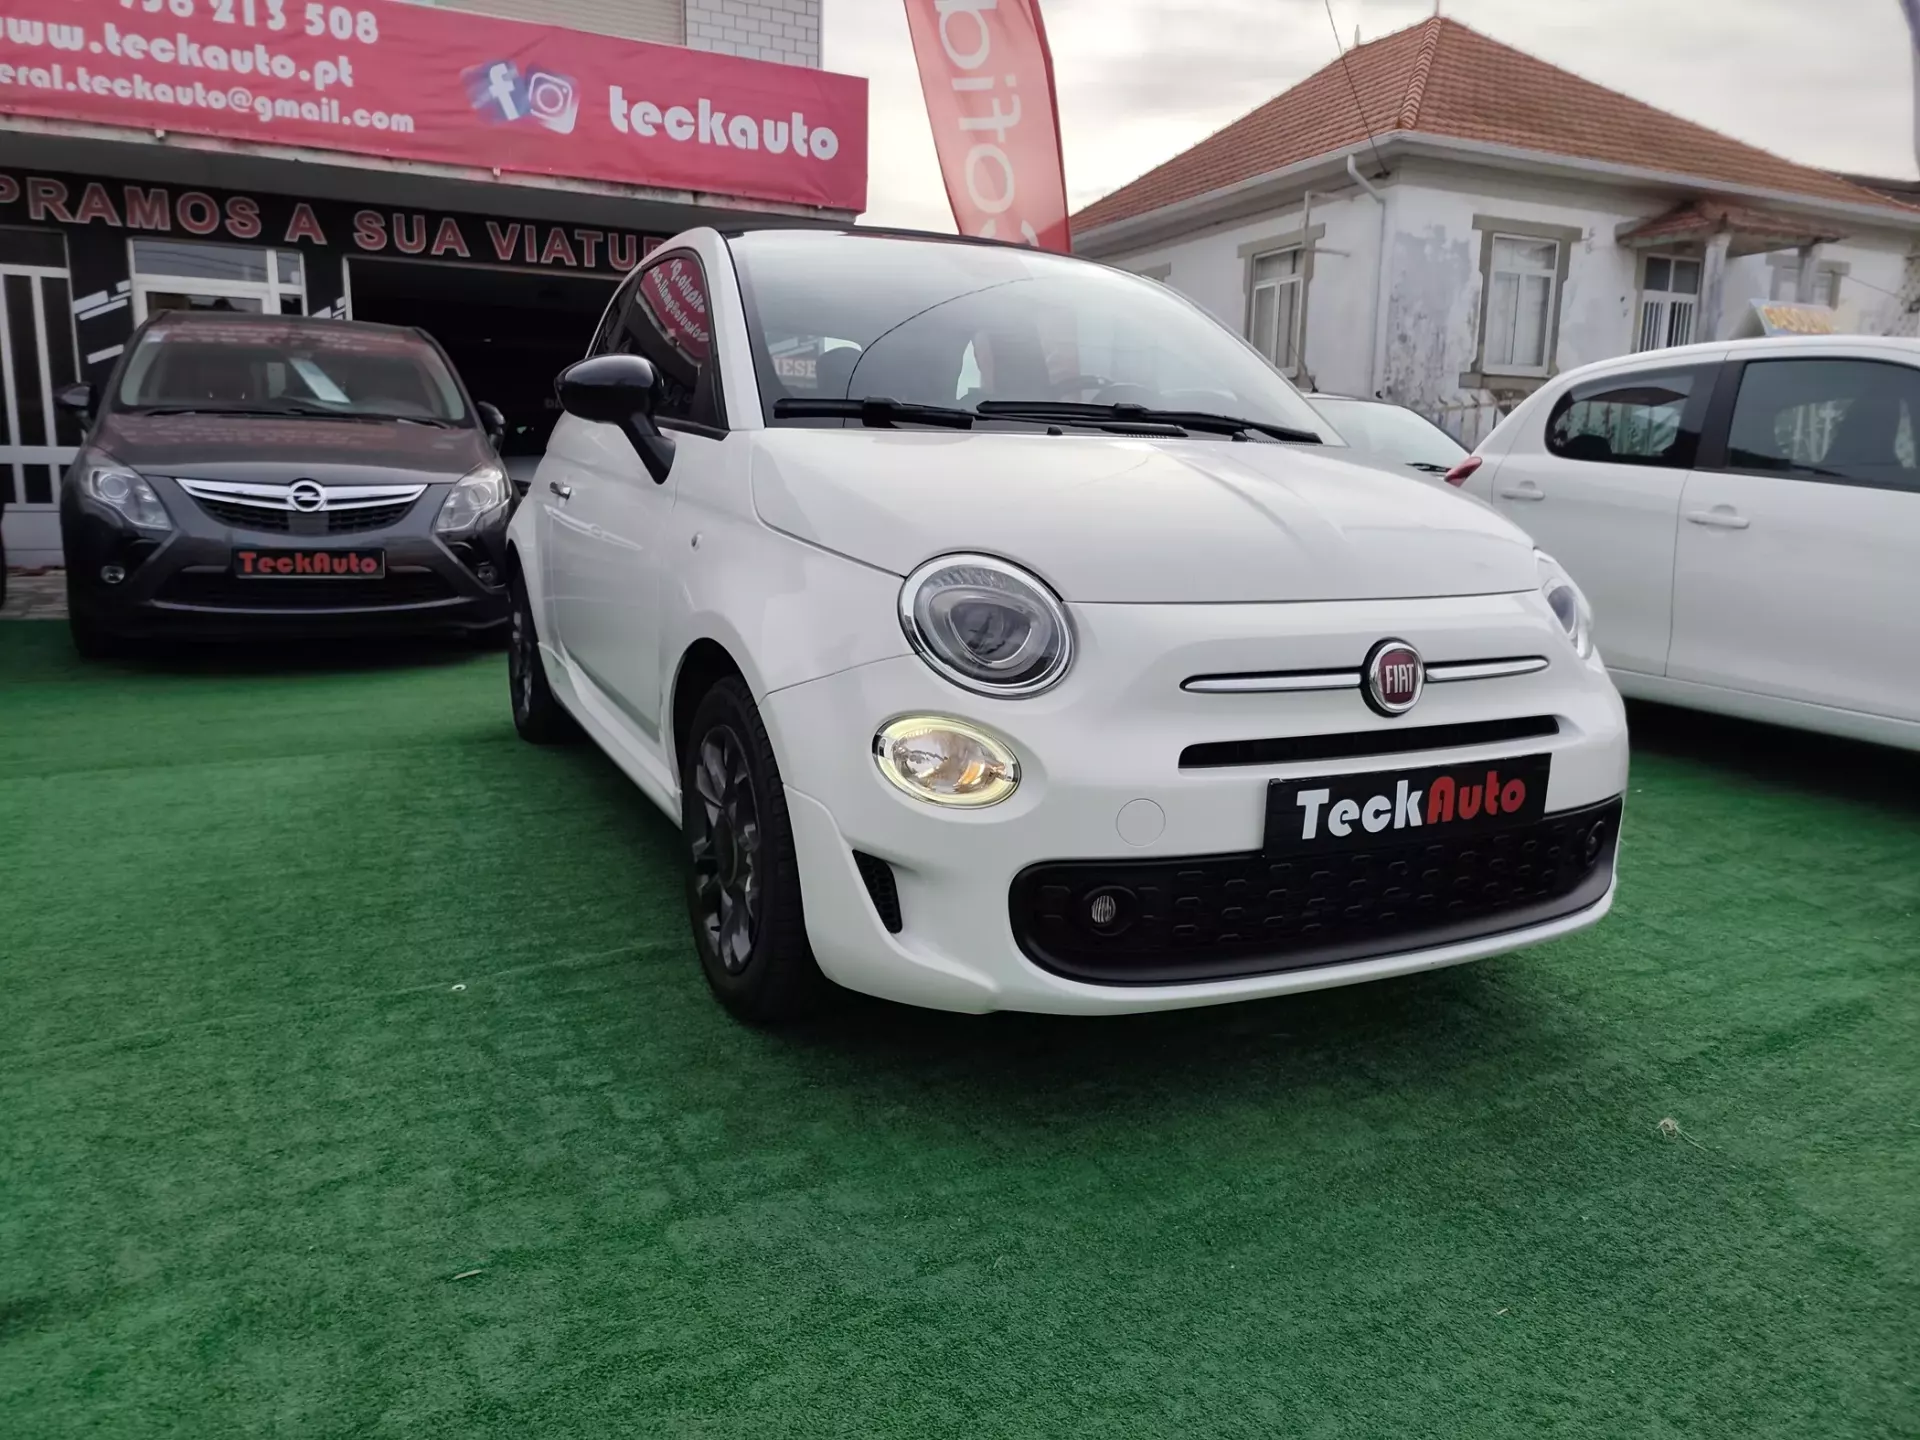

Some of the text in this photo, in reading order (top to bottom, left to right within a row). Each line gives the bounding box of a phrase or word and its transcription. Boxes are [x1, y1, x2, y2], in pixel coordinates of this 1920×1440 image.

[305, 3, 378, 44] 508
[0, 15, 354, 91] ww.teckauto.pt
[609, 85, 839, 161] teckauto
[284, 203, 327, 246] A
[353, 210, 471, 258] SUA
[238, 551, 378, 574] TeckAuto
[1385, 663, 1415, 694] FIAT
[1296, 770, 1527, 840] TeckAuto
